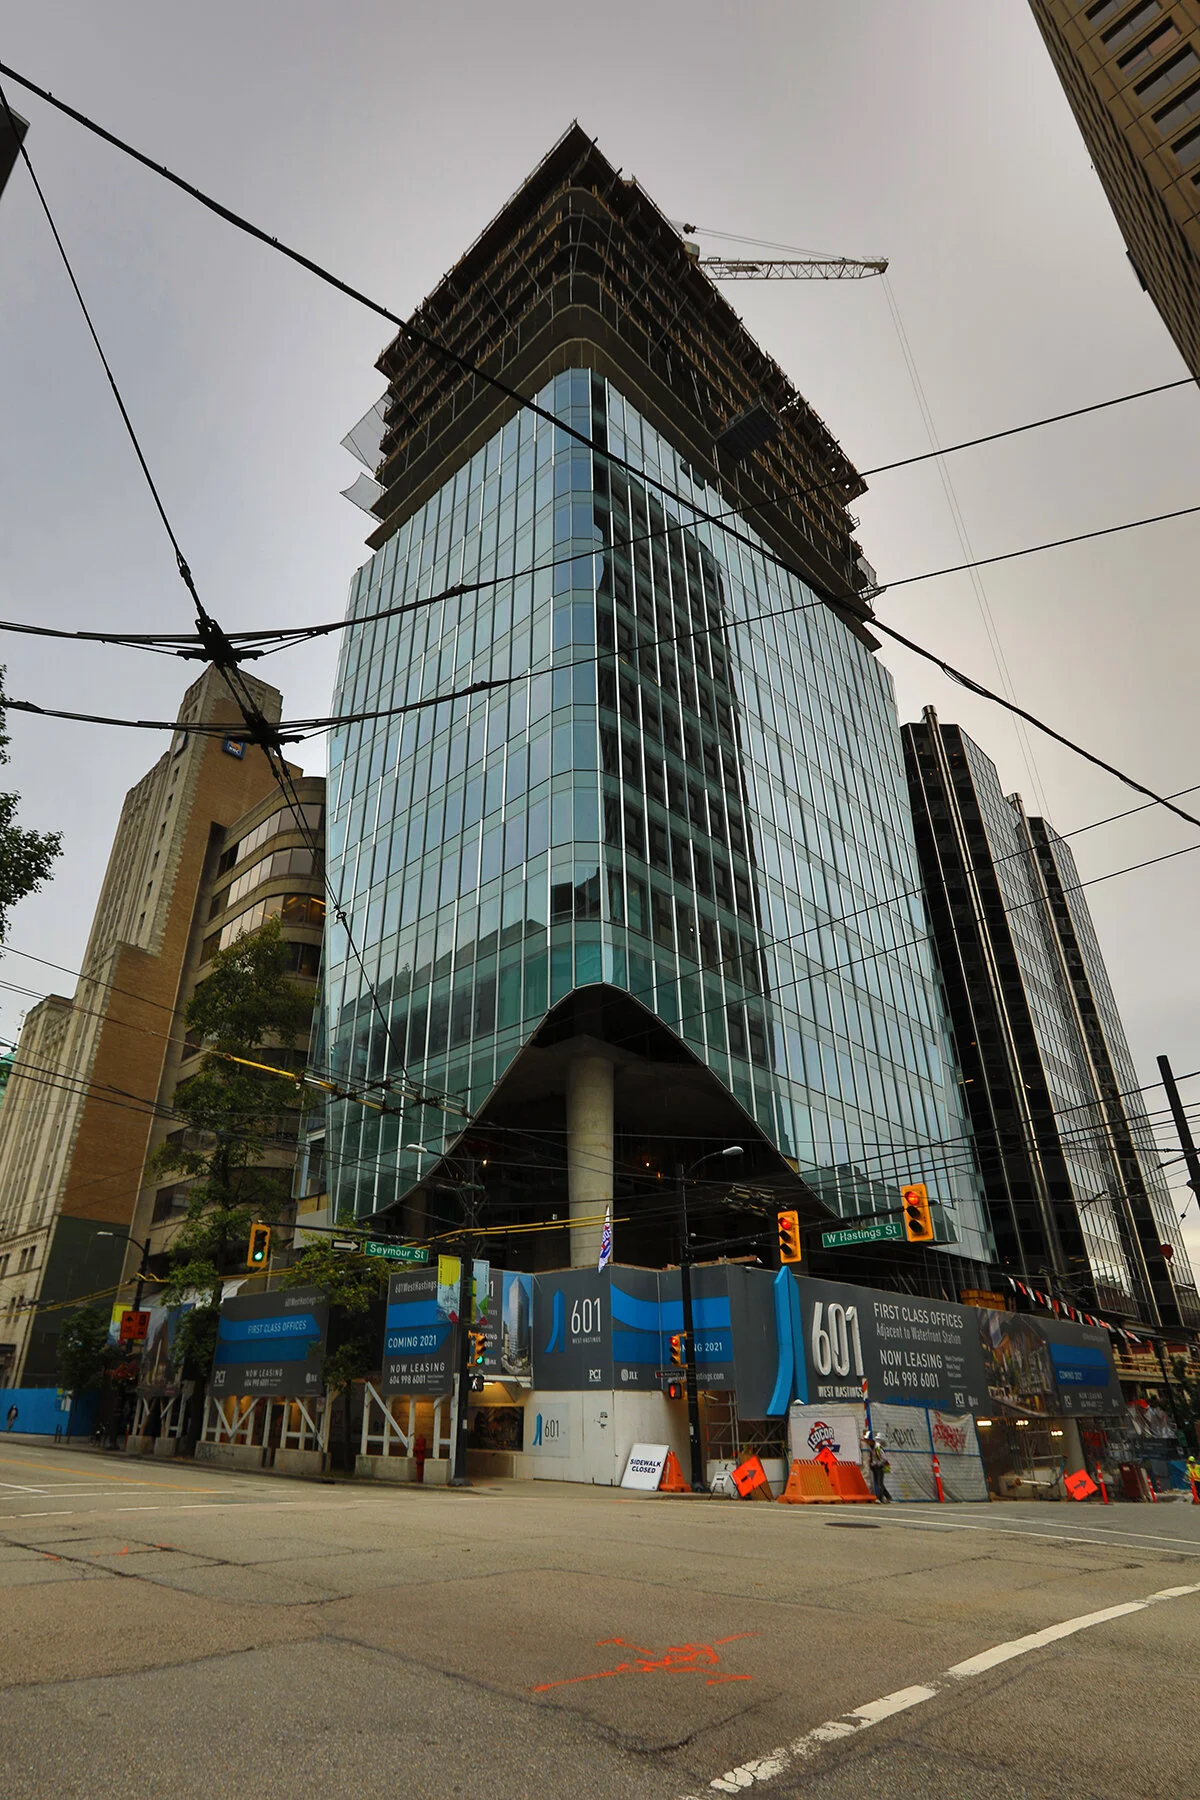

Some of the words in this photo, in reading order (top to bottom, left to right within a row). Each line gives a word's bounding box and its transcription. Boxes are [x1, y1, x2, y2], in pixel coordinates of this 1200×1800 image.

[827, 1234, 836, 1243] W
[840, 1228, 881, 1242] Hastings
[885, 1225, 897, 1235] St
[369, 1243, 411, 1258] Seymour
[414, 1250, 424, 1259] St
[571, 1297, 601, 1334] 601
[873, 1302, 900, 1320] FIRST
[901, 1306, 930, 1324] CLASS
[930, 1311, 963, 1329] OFFICES
[247, 1324, 262, 1334] FIRST
[264, 1322, 281, 1333] CLASS
[282, 1320, 307, 1331] OFFICES
[876, 1322, 903, 1340] Adjacent
[904, 1327, 911, 1340] to
[910, 1326, 942, 1343] Waterfront
[941, 1330, 962, 1345] Station
[387, 1337, 418, 1348] COMING
[419, 1335, 437, 1346] 2021
[704, 1342, 723, 1352] 2021
[812, 1302, 864, 1377] 601
[880, 1349, 902, 1366] NOW
[904, 1351, 943, 1369] LEASING
[259, 1368, 283, 1377] LEASING
[390, 1364, 408, 1373] NOW
[410, 1362, 445, 1373] LEASING
[589, 1369, 601, 1379] PCI
[389, 1375, 400, 1385] 604
[401, 1375, 411, 1385] 998
[412, 1374, 426, 1384] 6001
[883, 1370, 900, 1387] 604
[901, 1371, 918, 1387] 998
[920, 1372, 940, 1388] 6001
[817, 1385, 834, 1398] WEST
[835, 1385, 864, 1398] HASTINGS
[544, 1419, 559, 1438] 601
[808, 1426, 835, 1452] LEDCOR
[630, 1459, 662, 1467] SIDEWALK
[631, 1465, 656, 1474] CLOSED
